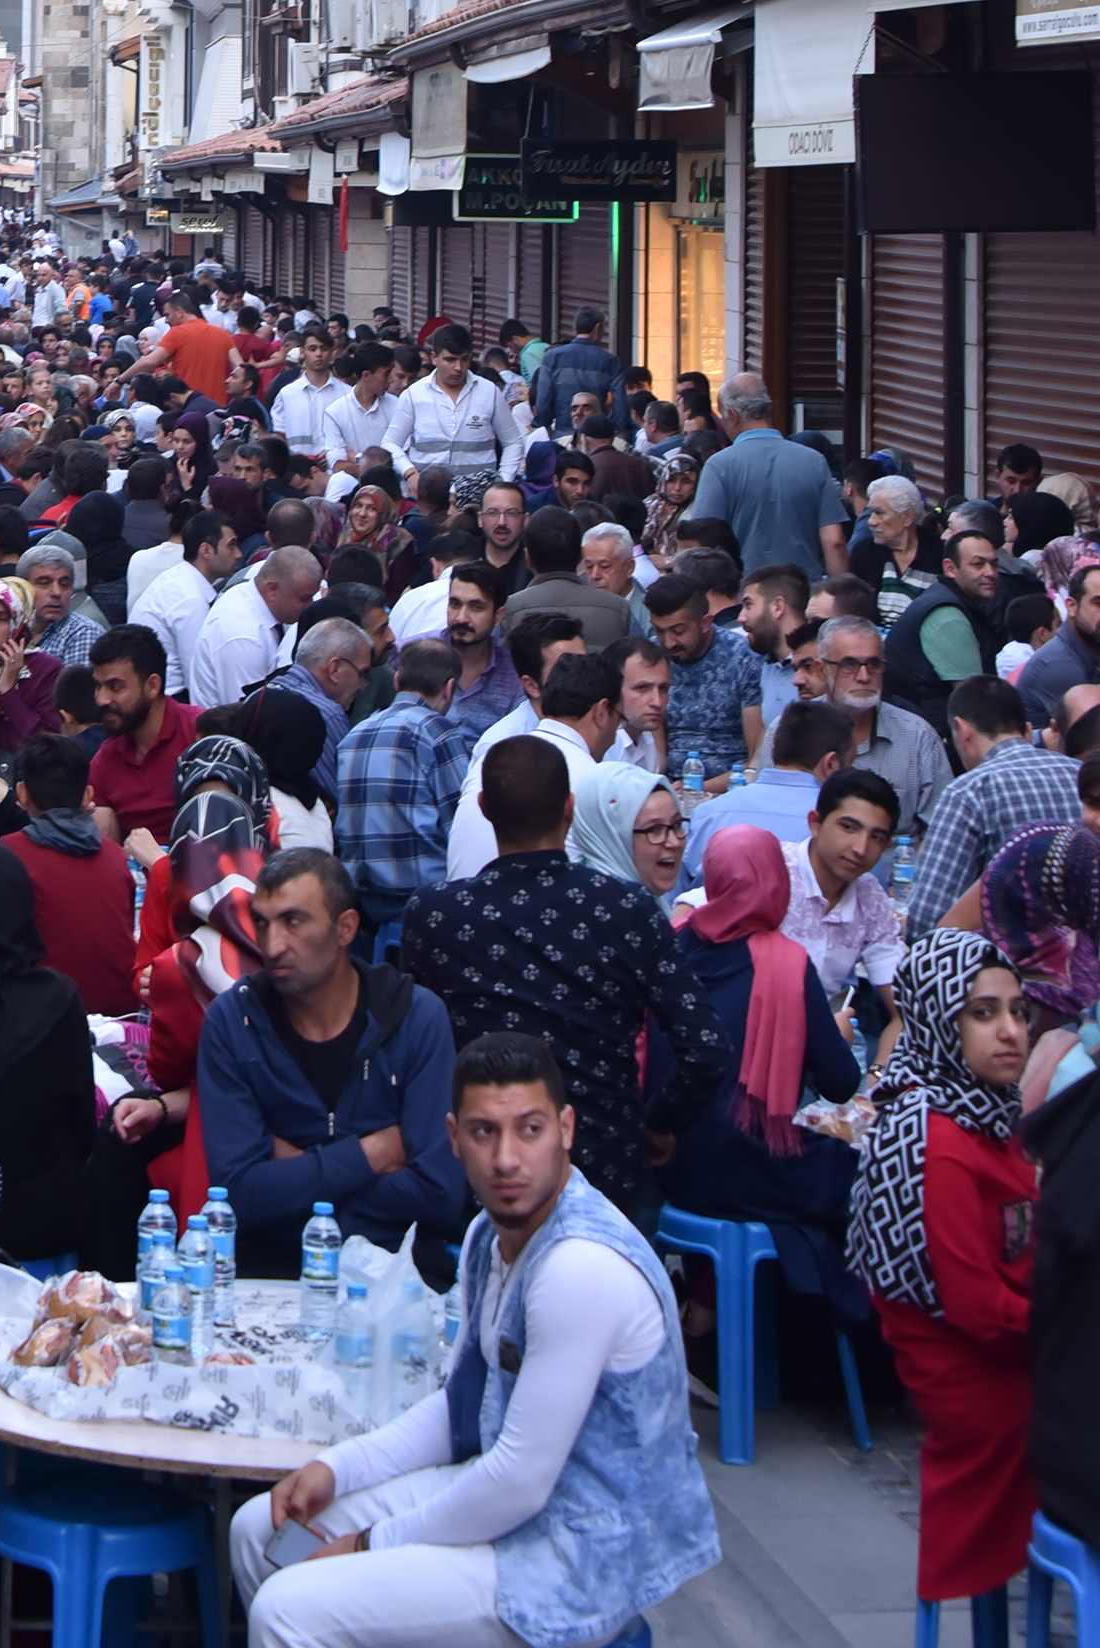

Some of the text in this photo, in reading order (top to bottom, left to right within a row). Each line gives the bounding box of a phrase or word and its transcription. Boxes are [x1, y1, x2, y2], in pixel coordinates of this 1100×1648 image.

[788, 123, 833, 155] ODACI DÖVİZ
[527, 149, 591, 174] Fuat
